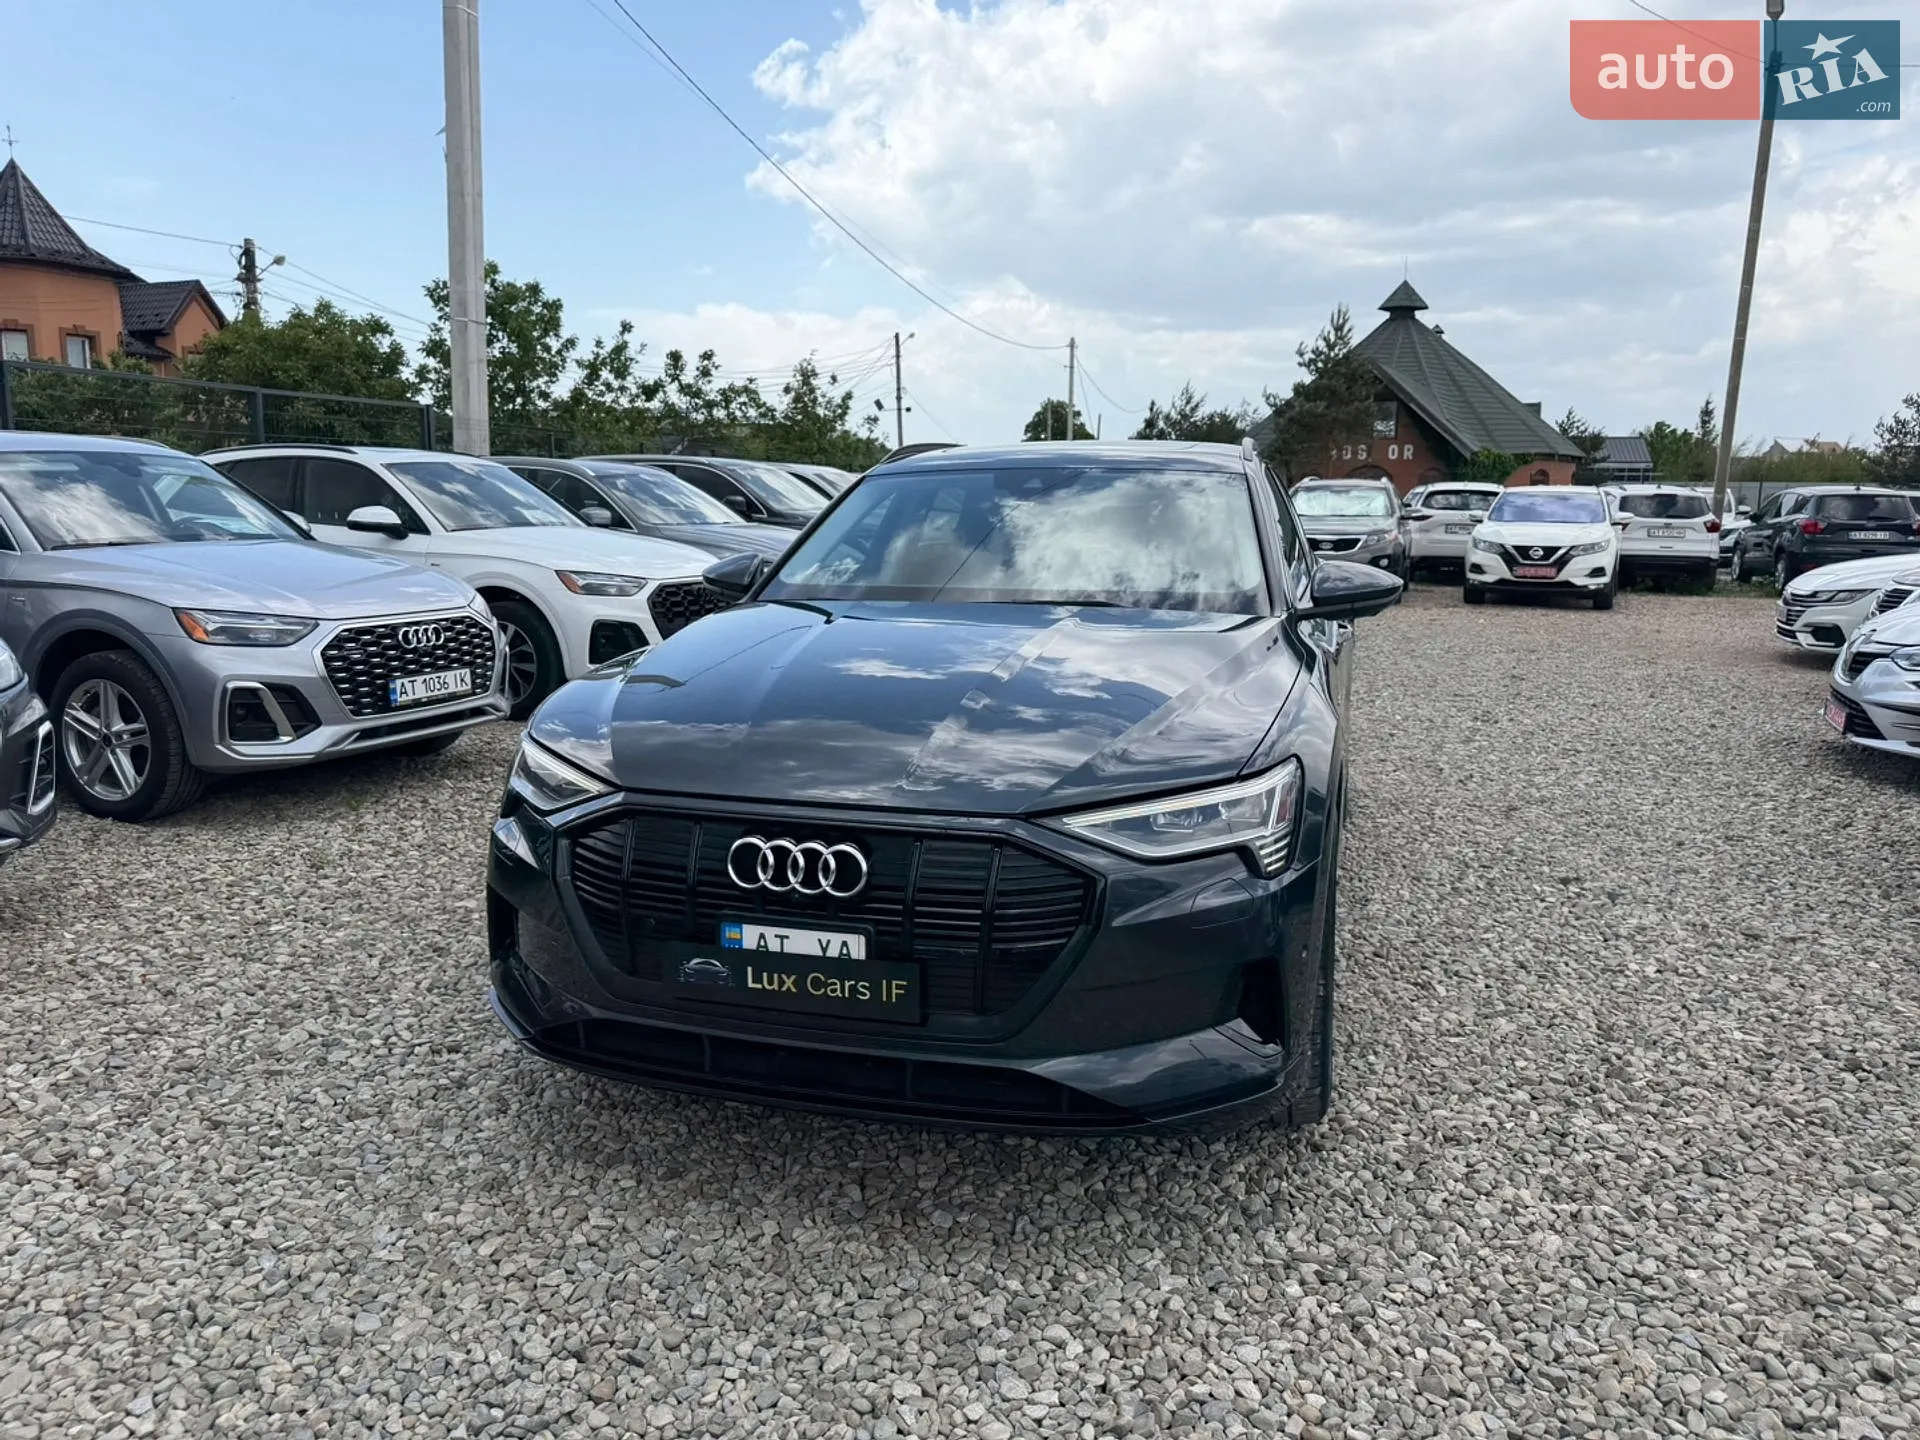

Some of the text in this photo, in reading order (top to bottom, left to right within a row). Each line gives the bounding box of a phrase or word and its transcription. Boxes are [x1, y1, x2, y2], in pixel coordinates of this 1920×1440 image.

[399, 671, 469, 699] AT 1036 IK
[756, 932, 790, 953] AT
[747, 966, 908, 1002] Lux Cars IF
